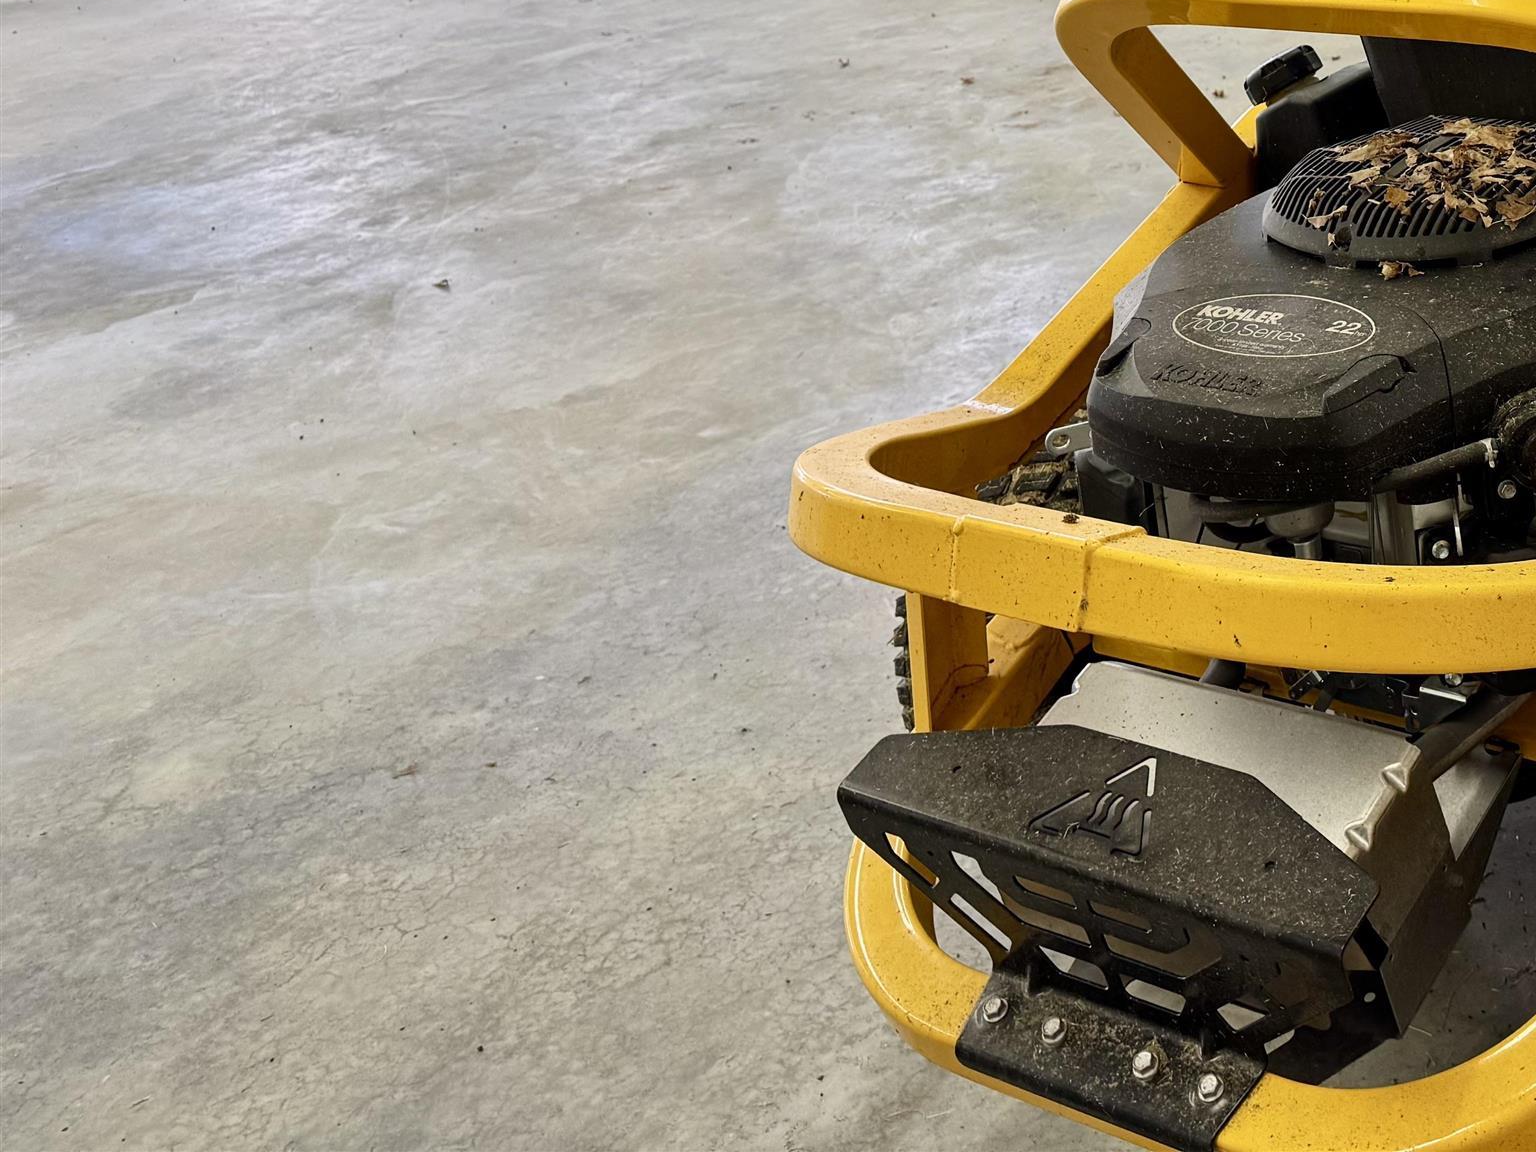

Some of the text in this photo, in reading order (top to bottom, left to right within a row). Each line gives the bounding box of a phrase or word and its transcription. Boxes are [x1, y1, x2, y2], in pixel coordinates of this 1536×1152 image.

[1196, 304, 1282, 325] KOHLER
[1181, 317, 1239, 334] 7000
[1238, 323, 1305, 343] Series
[1325, 320, 1362, 335] 22
[1150, 363, 1262, 397] KOHLER
